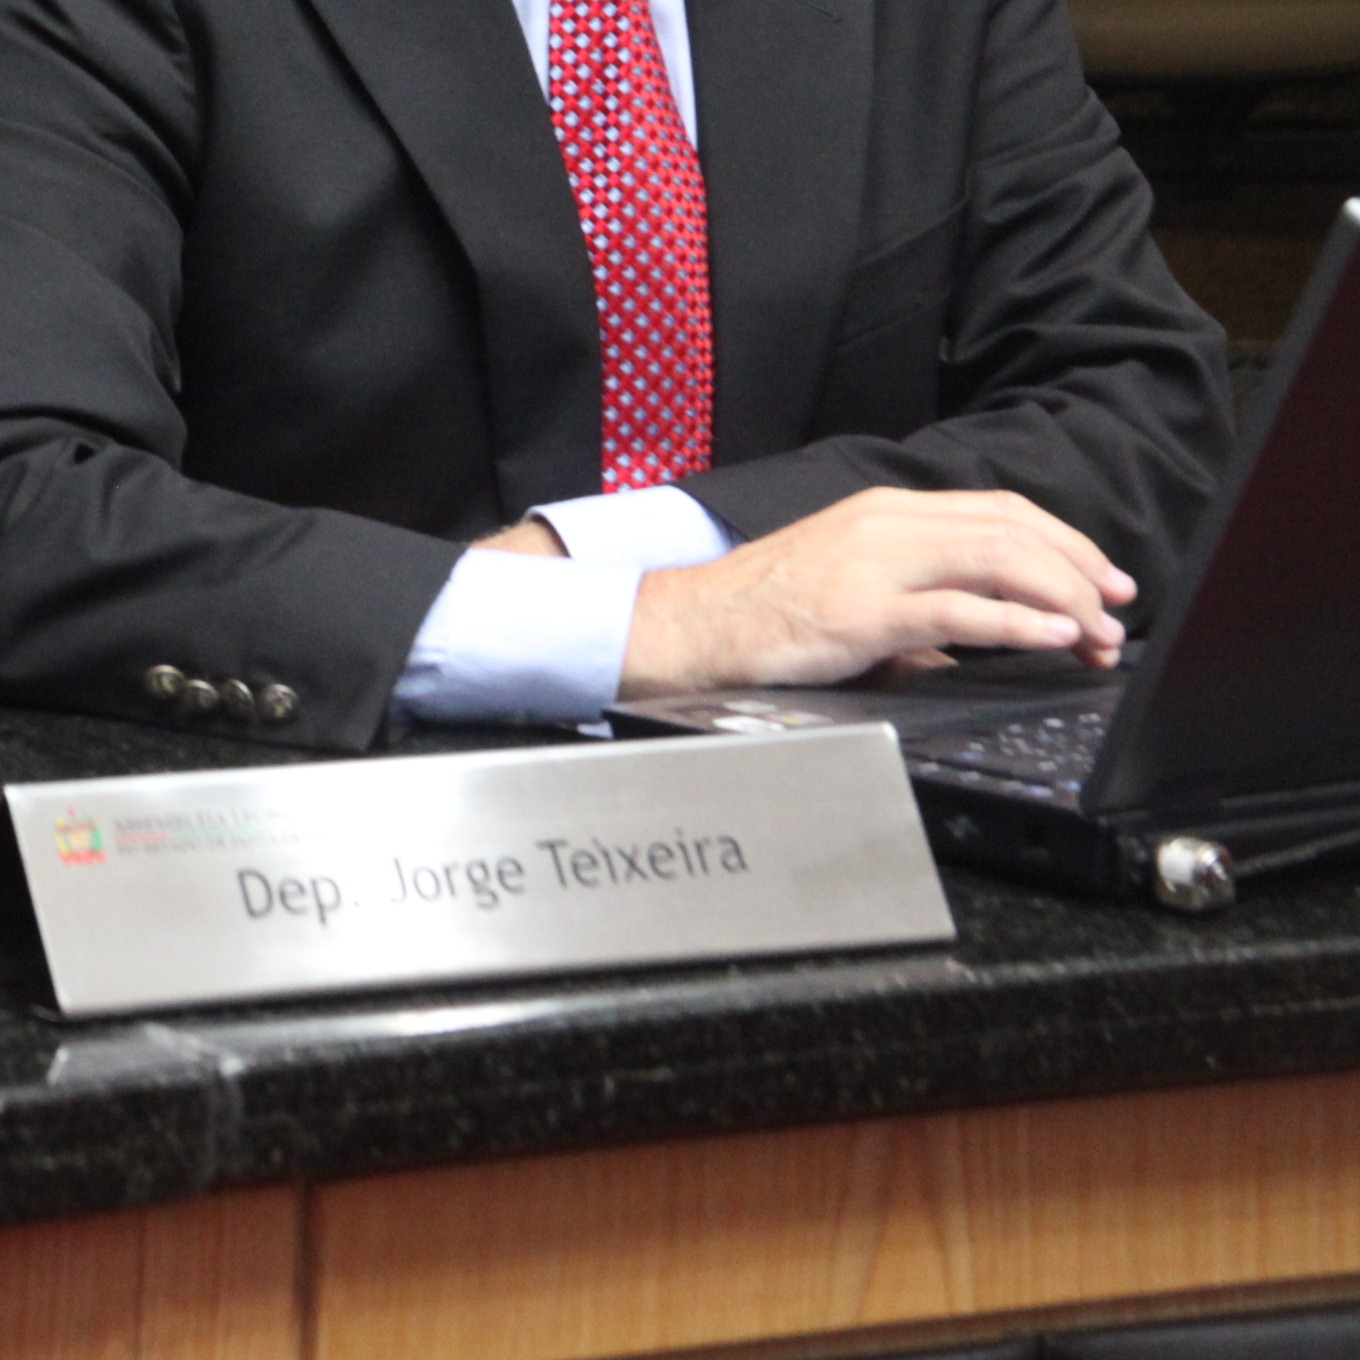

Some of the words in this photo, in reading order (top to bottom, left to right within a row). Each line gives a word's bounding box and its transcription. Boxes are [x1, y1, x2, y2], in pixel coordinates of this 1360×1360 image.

[237, 869, 359, 926] Dep.
[390, 856, 525, 910] Jorge
[535, 828, 749, 890] Teixeira
